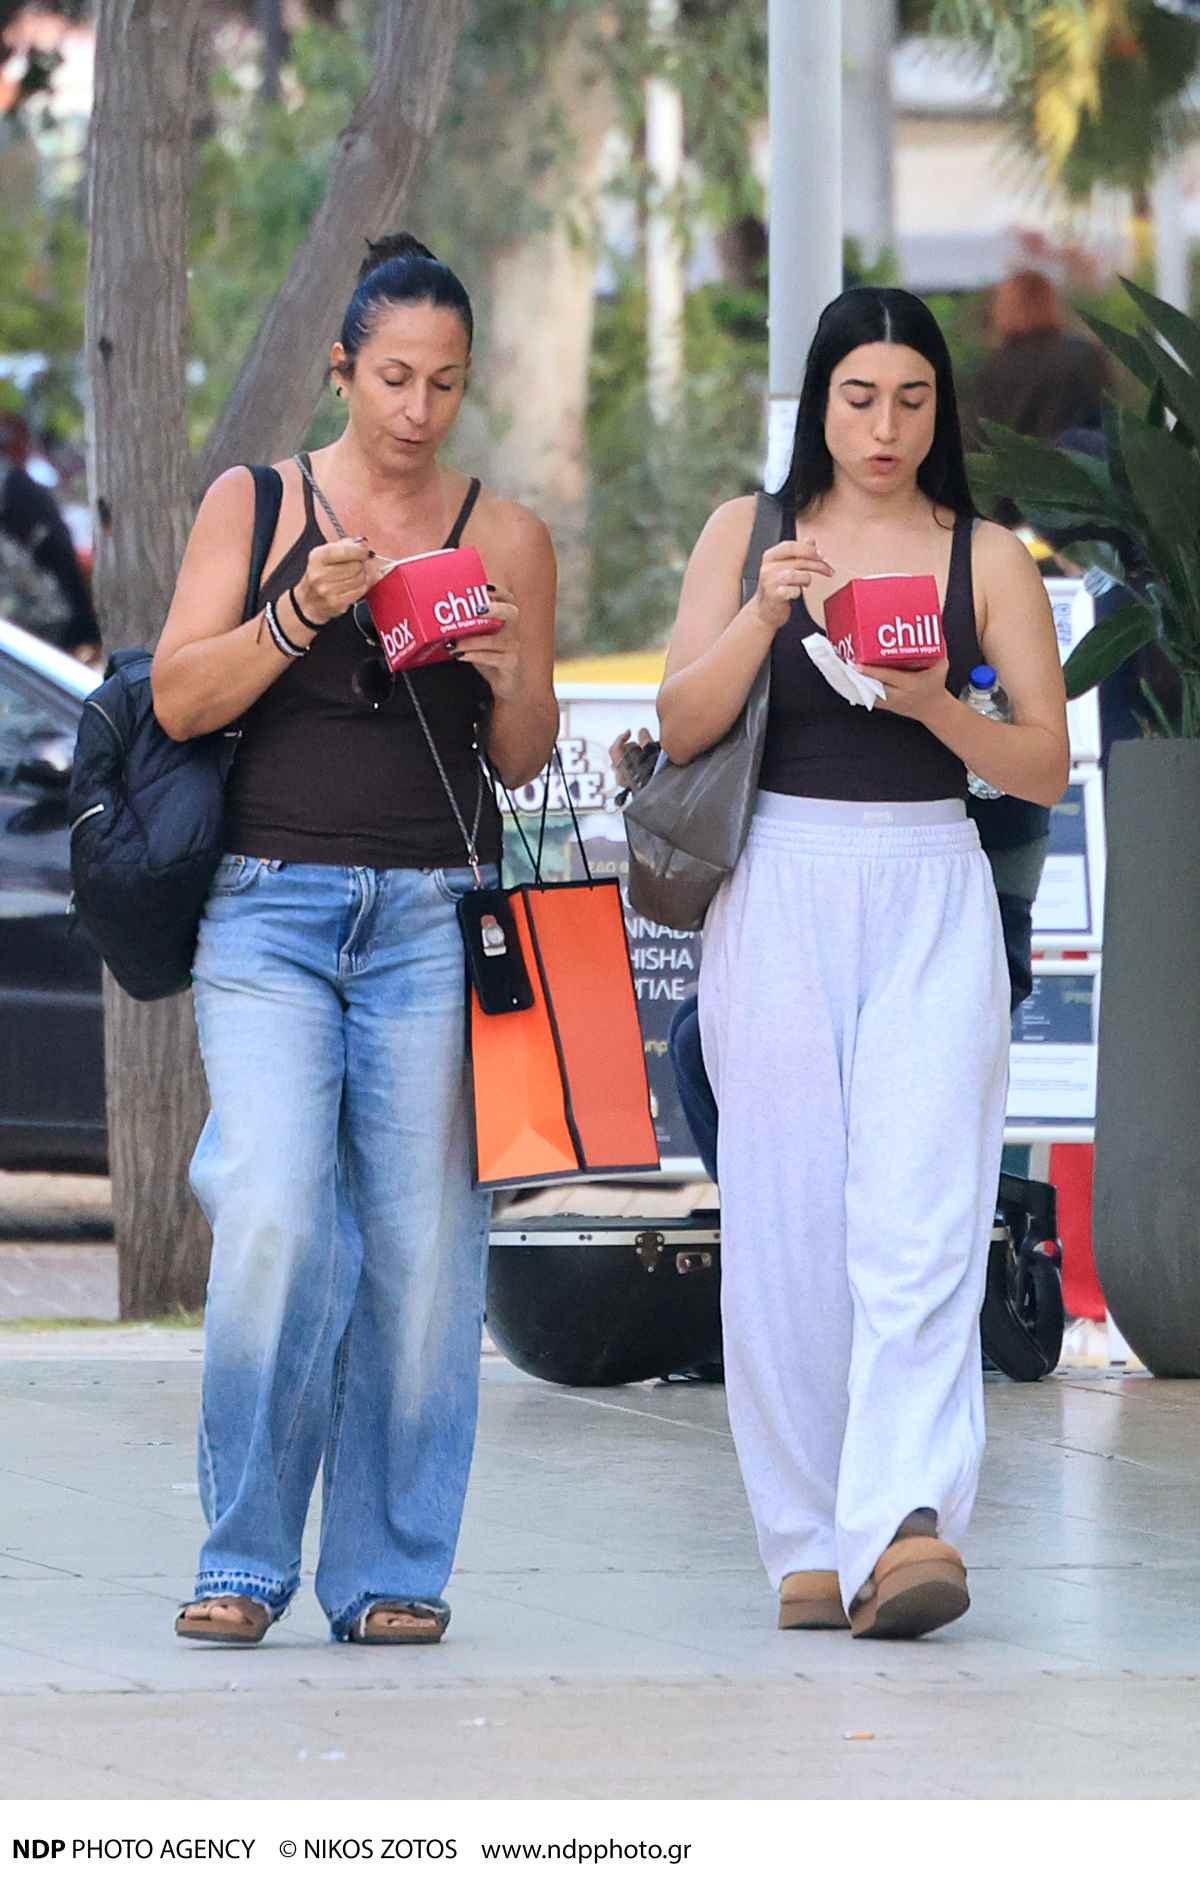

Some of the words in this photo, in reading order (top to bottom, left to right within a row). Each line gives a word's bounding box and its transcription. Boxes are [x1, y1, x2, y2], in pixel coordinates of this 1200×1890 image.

[433, 584, 491, 625] chill
[380, 617, 414, 658] box
[833, 633, 855, 658] ox
[877, 614, 941, 648] chill
[631, 947, 694, 970] HISHA
